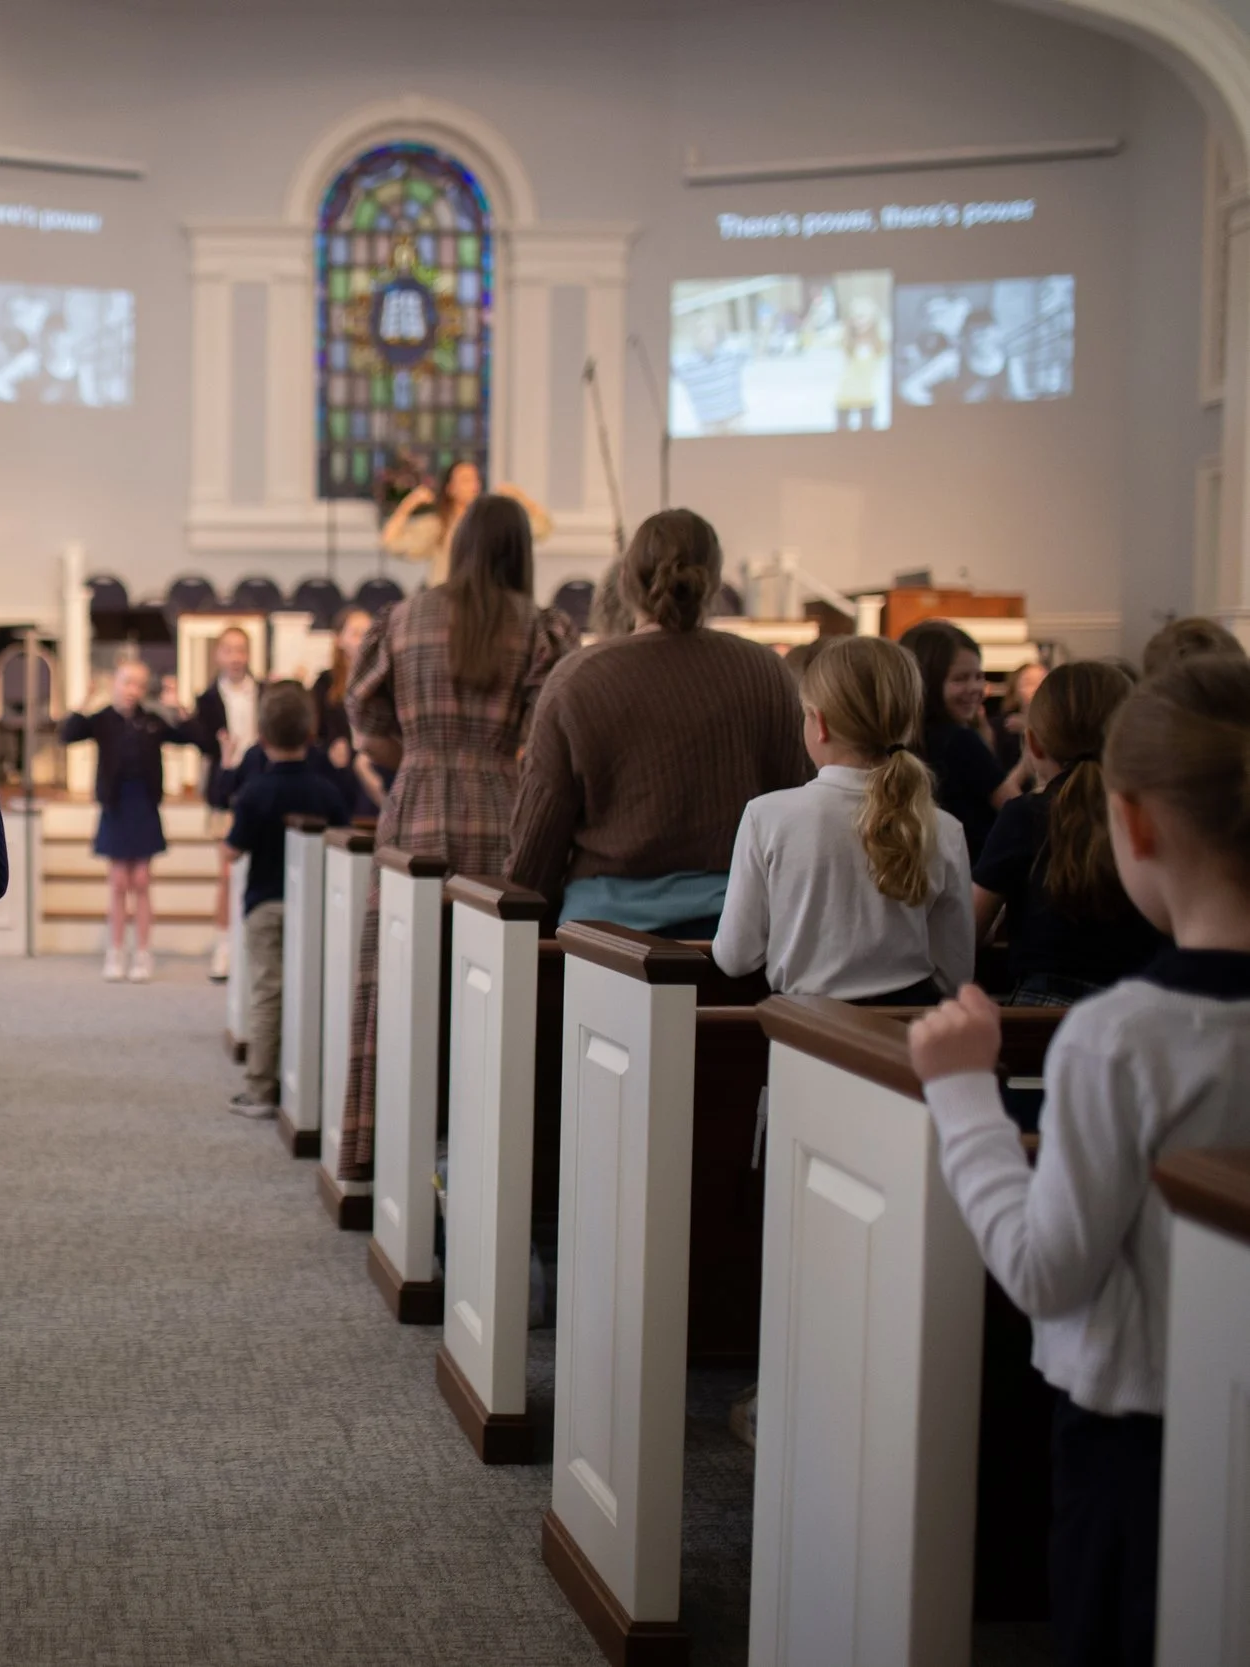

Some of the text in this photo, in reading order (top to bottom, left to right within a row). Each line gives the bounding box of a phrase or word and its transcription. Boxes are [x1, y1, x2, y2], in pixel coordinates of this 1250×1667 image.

[718, 199, 1035, 239] There's power, there's power
